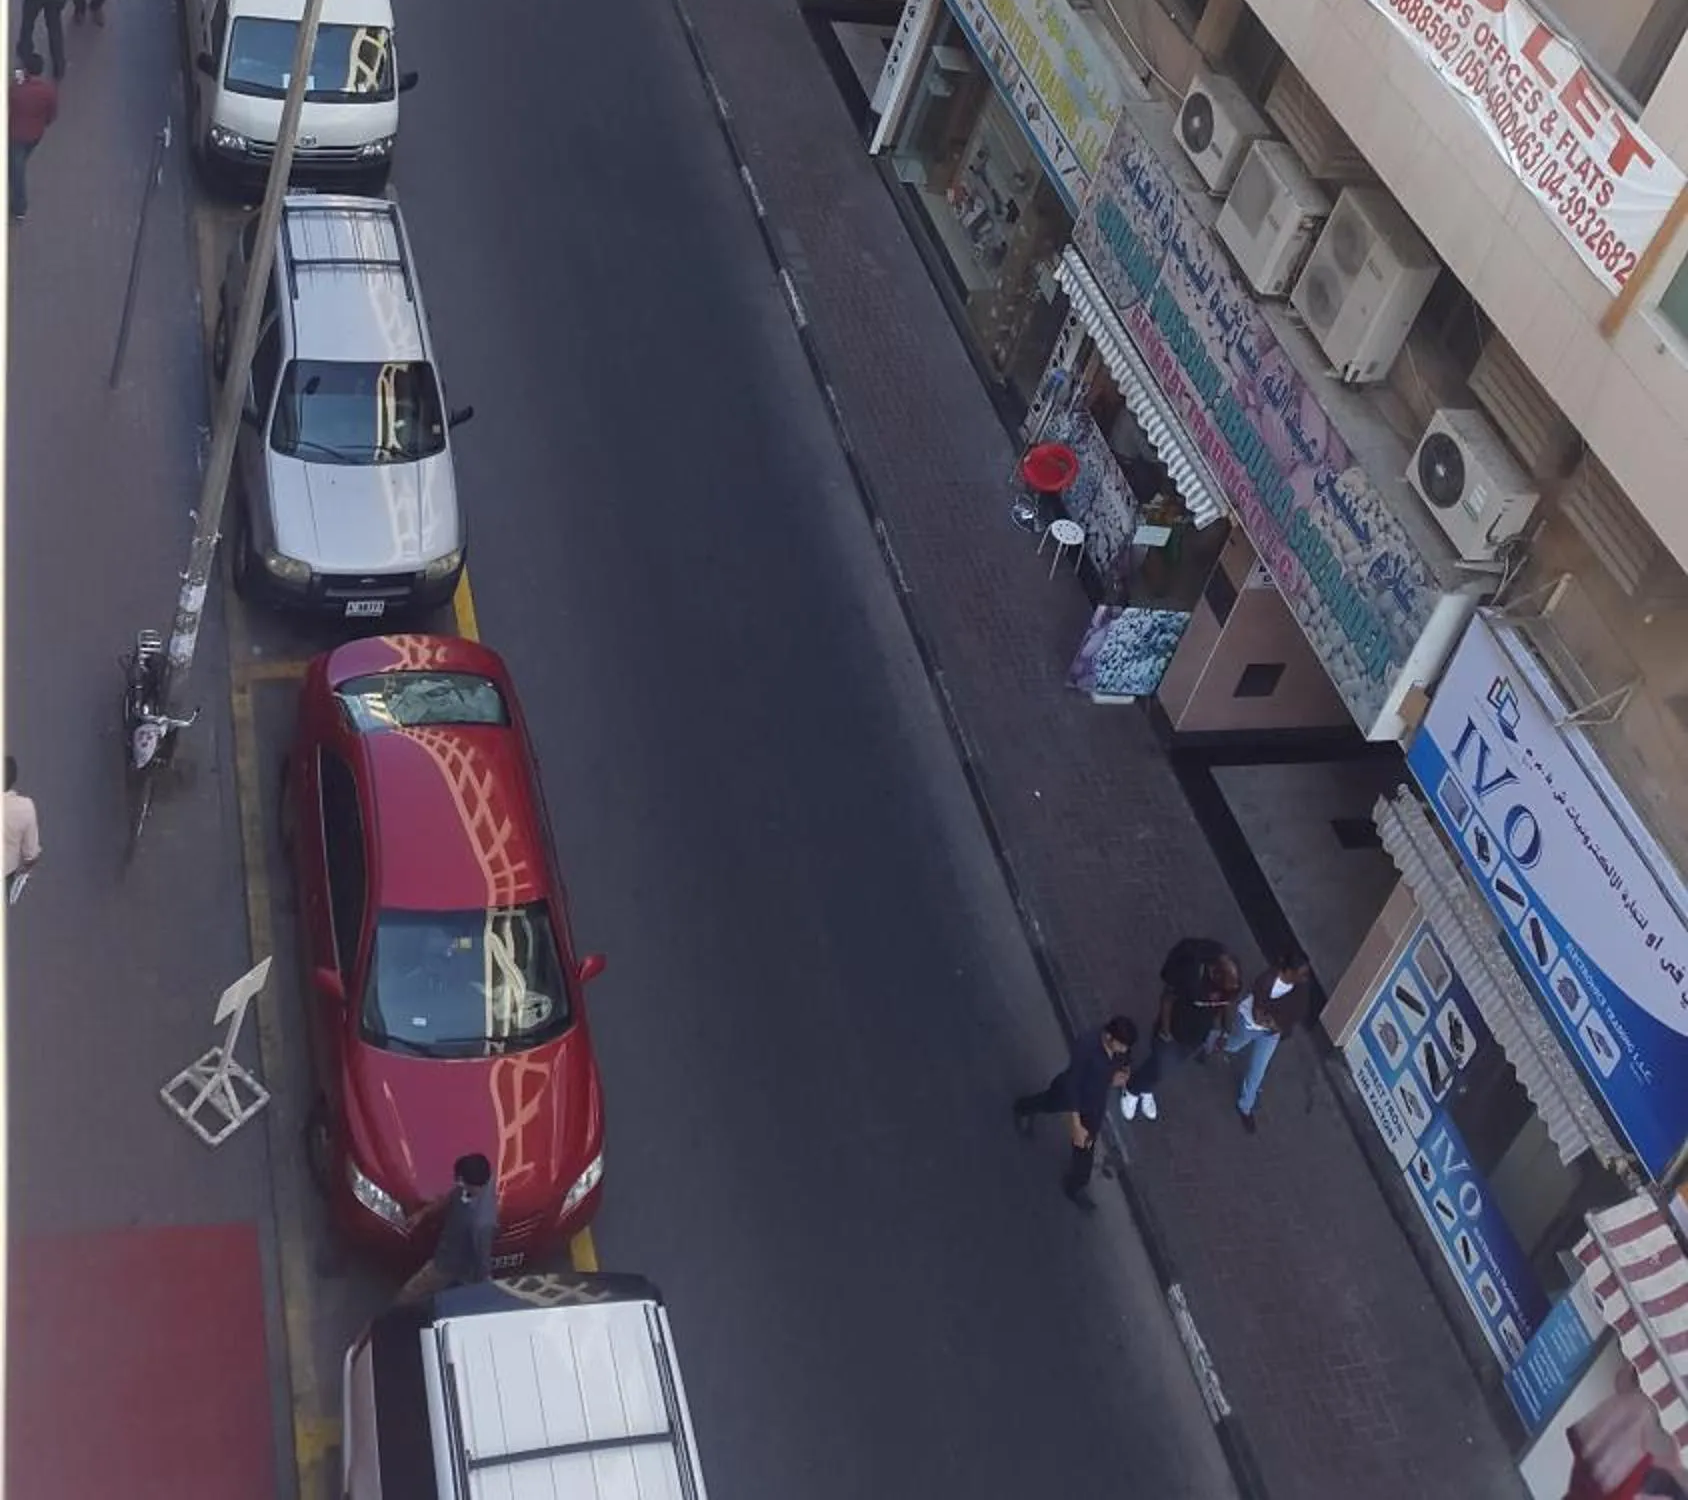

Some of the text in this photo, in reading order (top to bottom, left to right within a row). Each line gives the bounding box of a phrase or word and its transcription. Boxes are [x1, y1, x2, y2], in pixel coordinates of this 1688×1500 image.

[1473, 19, 1545, 117] OFFICES
[1539, 109, 1559, 137] &
[1555, 128, 1617, 208] FLATS
[1520, 20, 1656, 178] LET
[1449, 714, 1543, 873] IVO
[1430, 1125, 1482, 1220] IVO
